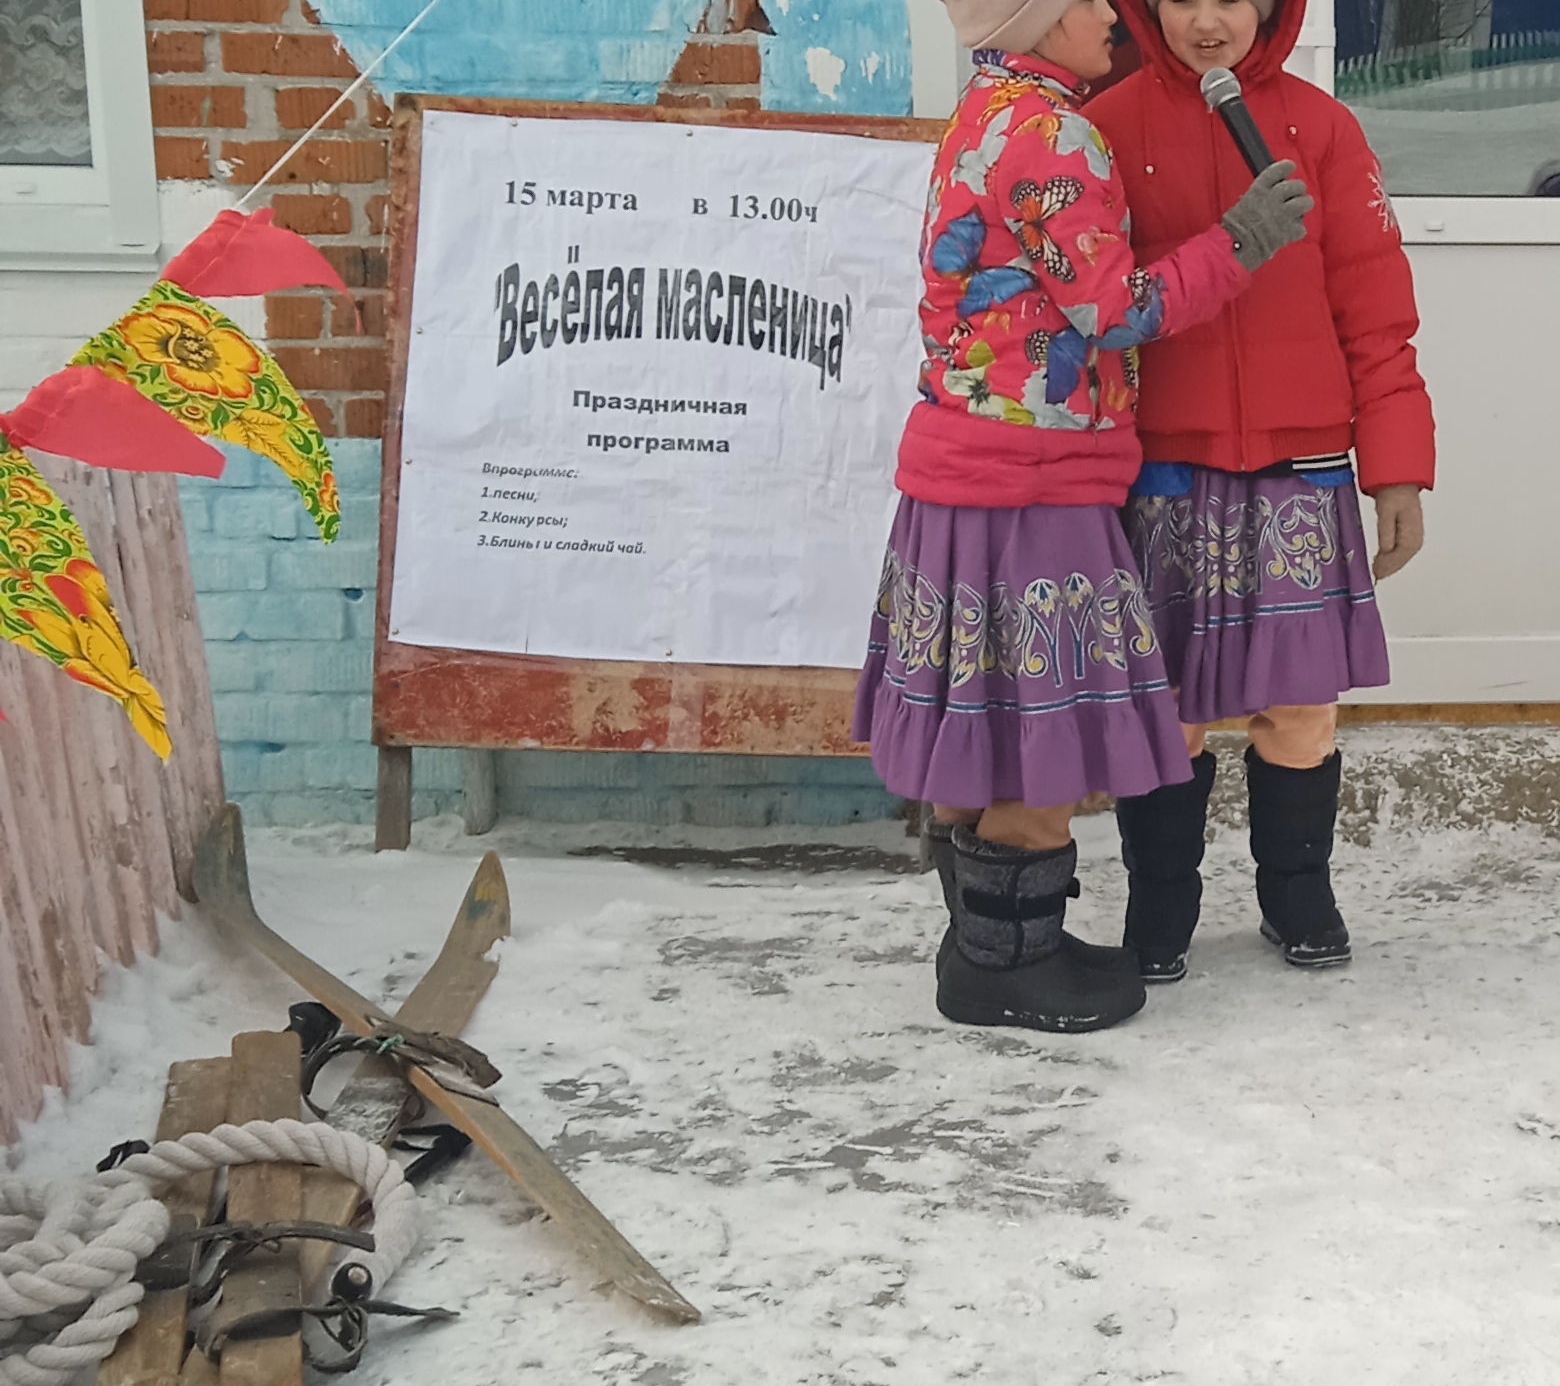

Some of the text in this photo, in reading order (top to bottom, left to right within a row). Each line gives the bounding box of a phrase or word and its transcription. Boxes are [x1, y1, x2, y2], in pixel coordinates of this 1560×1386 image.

[504, 180, 818, 223] 15 марта в 13.00ч
[572, 389, 748, 415] Праздничная
[587, 433, 730, 454] программа
[543, 539, 553, 550] и
[555, 539, 615, 553] сладкий
